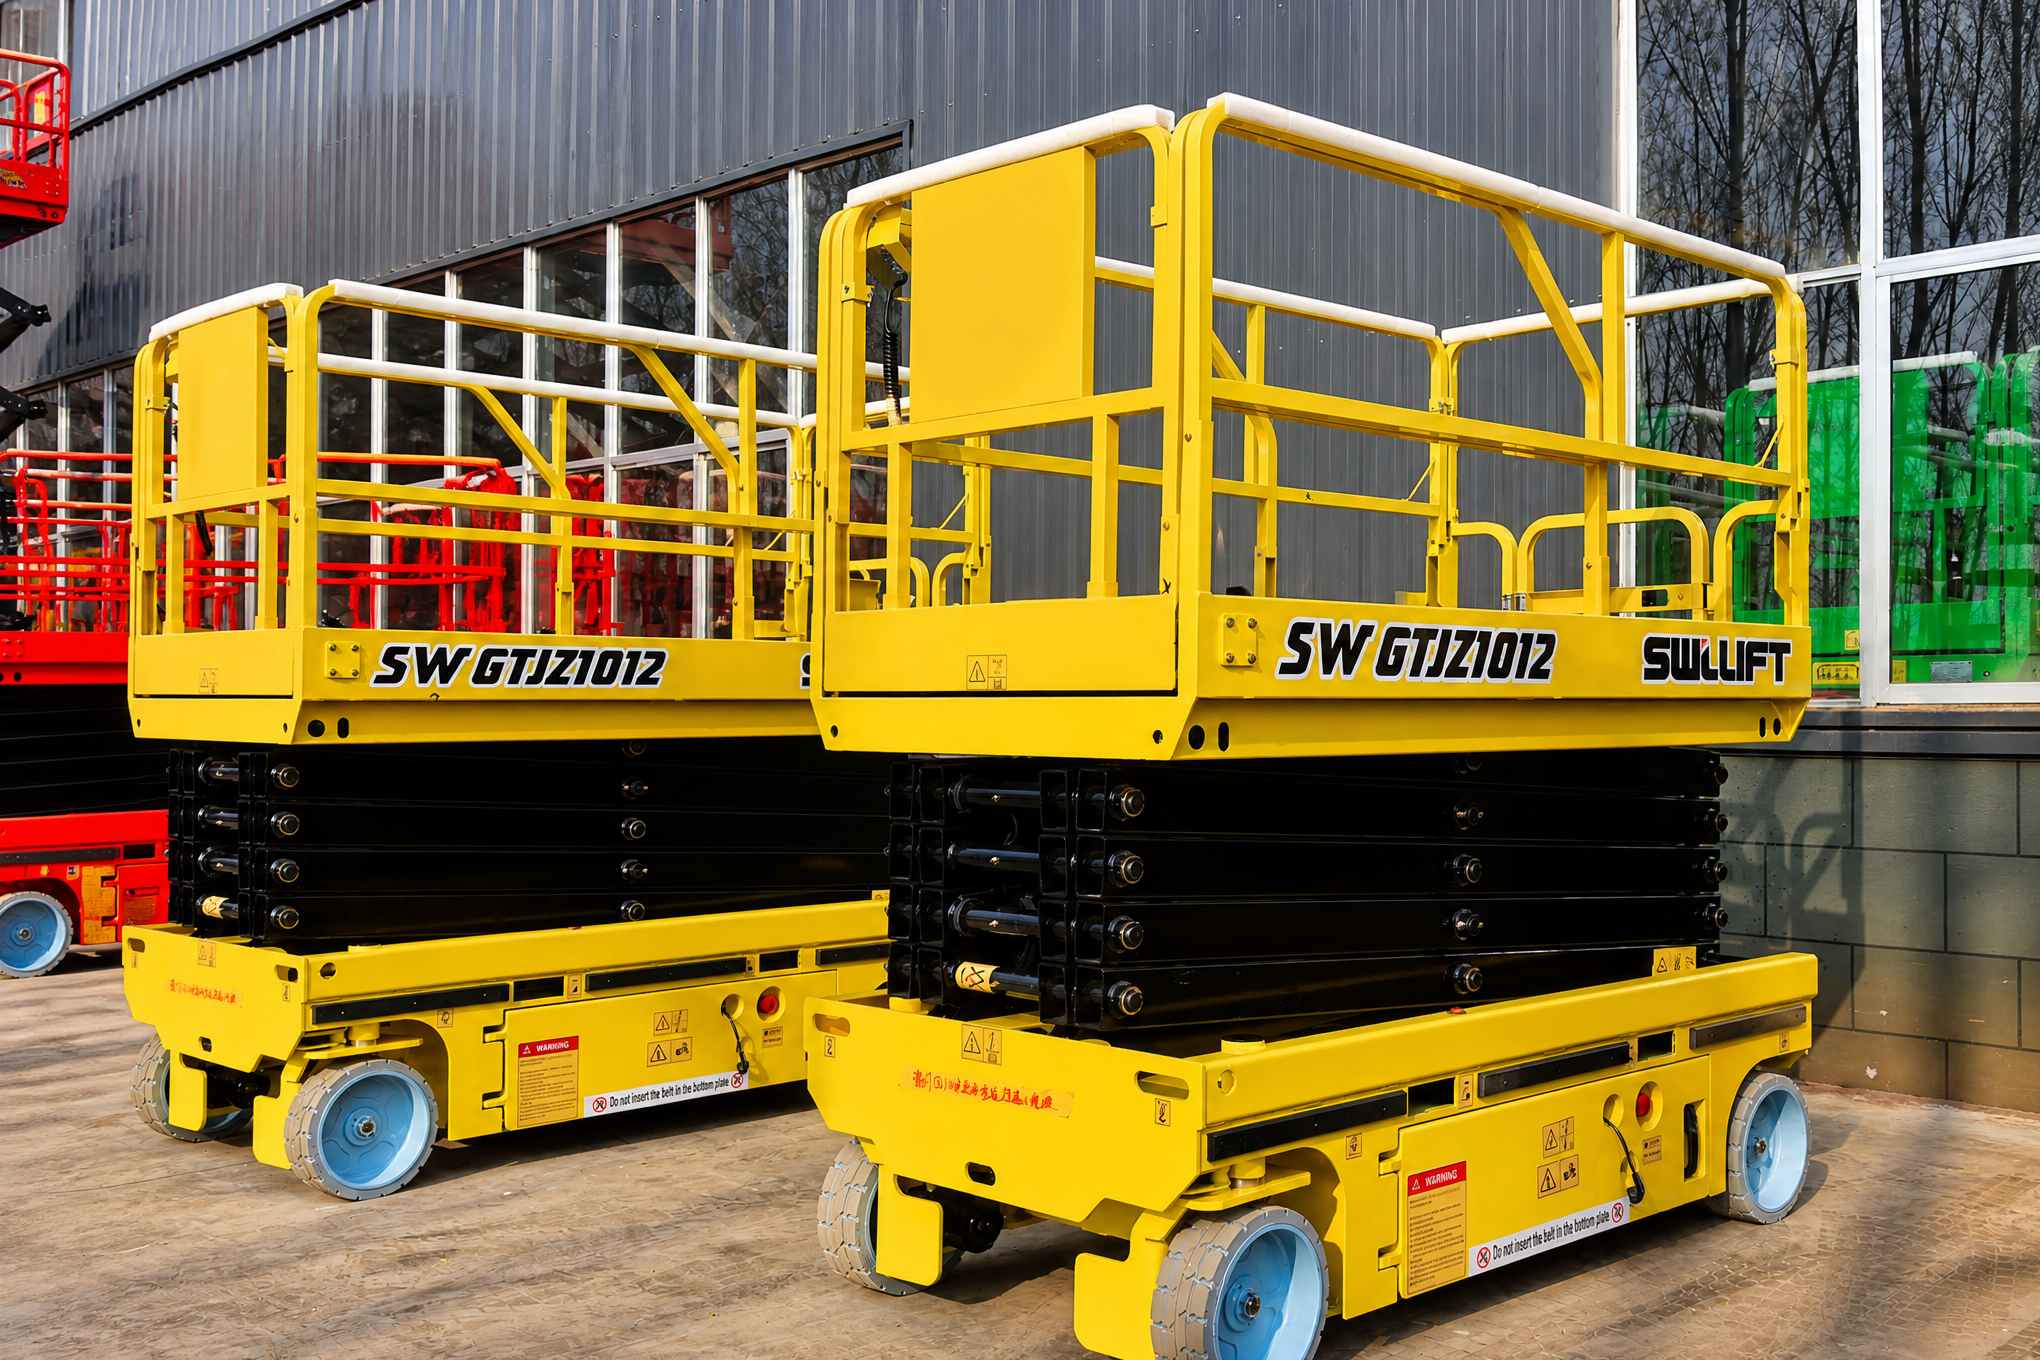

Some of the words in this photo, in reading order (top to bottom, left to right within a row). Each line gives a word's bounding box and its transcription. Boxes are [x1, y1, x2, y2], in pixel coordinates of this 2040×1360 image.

[371, 643, 476, 688] SW
[469, 645, 668, 688] GTJZ1012
[1276, 617, 1378, 680] SW
[1373, 622, 1557, 684] GTJZ1012
[536, 1041, 569, 1052] WARNING
[609, 1096, 619, 1108] Do
[619, 1094, 631, 1106] not
[631, 1090, 649, 1105] insert
[650, 1089, 660, 1100] the
[661, 1086, 674, 1098] belt
[675, 1085, 682, 1095] in
[682, 1083, 692, 1094] the
[693, 1080, 714, 1092] bottom
[714, 1077, 729, 1091] plate
[1425, 1169, 1458, 1187] WARNING
[1493, 1245, 1502, 1260] Do
[1503, 1240, 1514, 1257] not
[1514, 1234, 1532, 1252] insert
[1532, 1231, 1543, 1246] the
[1543, 1226, 1555, 1243] belt
[1556, 1224, 1563, 1238] in
[1563, 1221, 1573, 1237] the
[1574, 1214, 1595, 1233] bottom
[1596, 1208, 1610, 1229] plate
